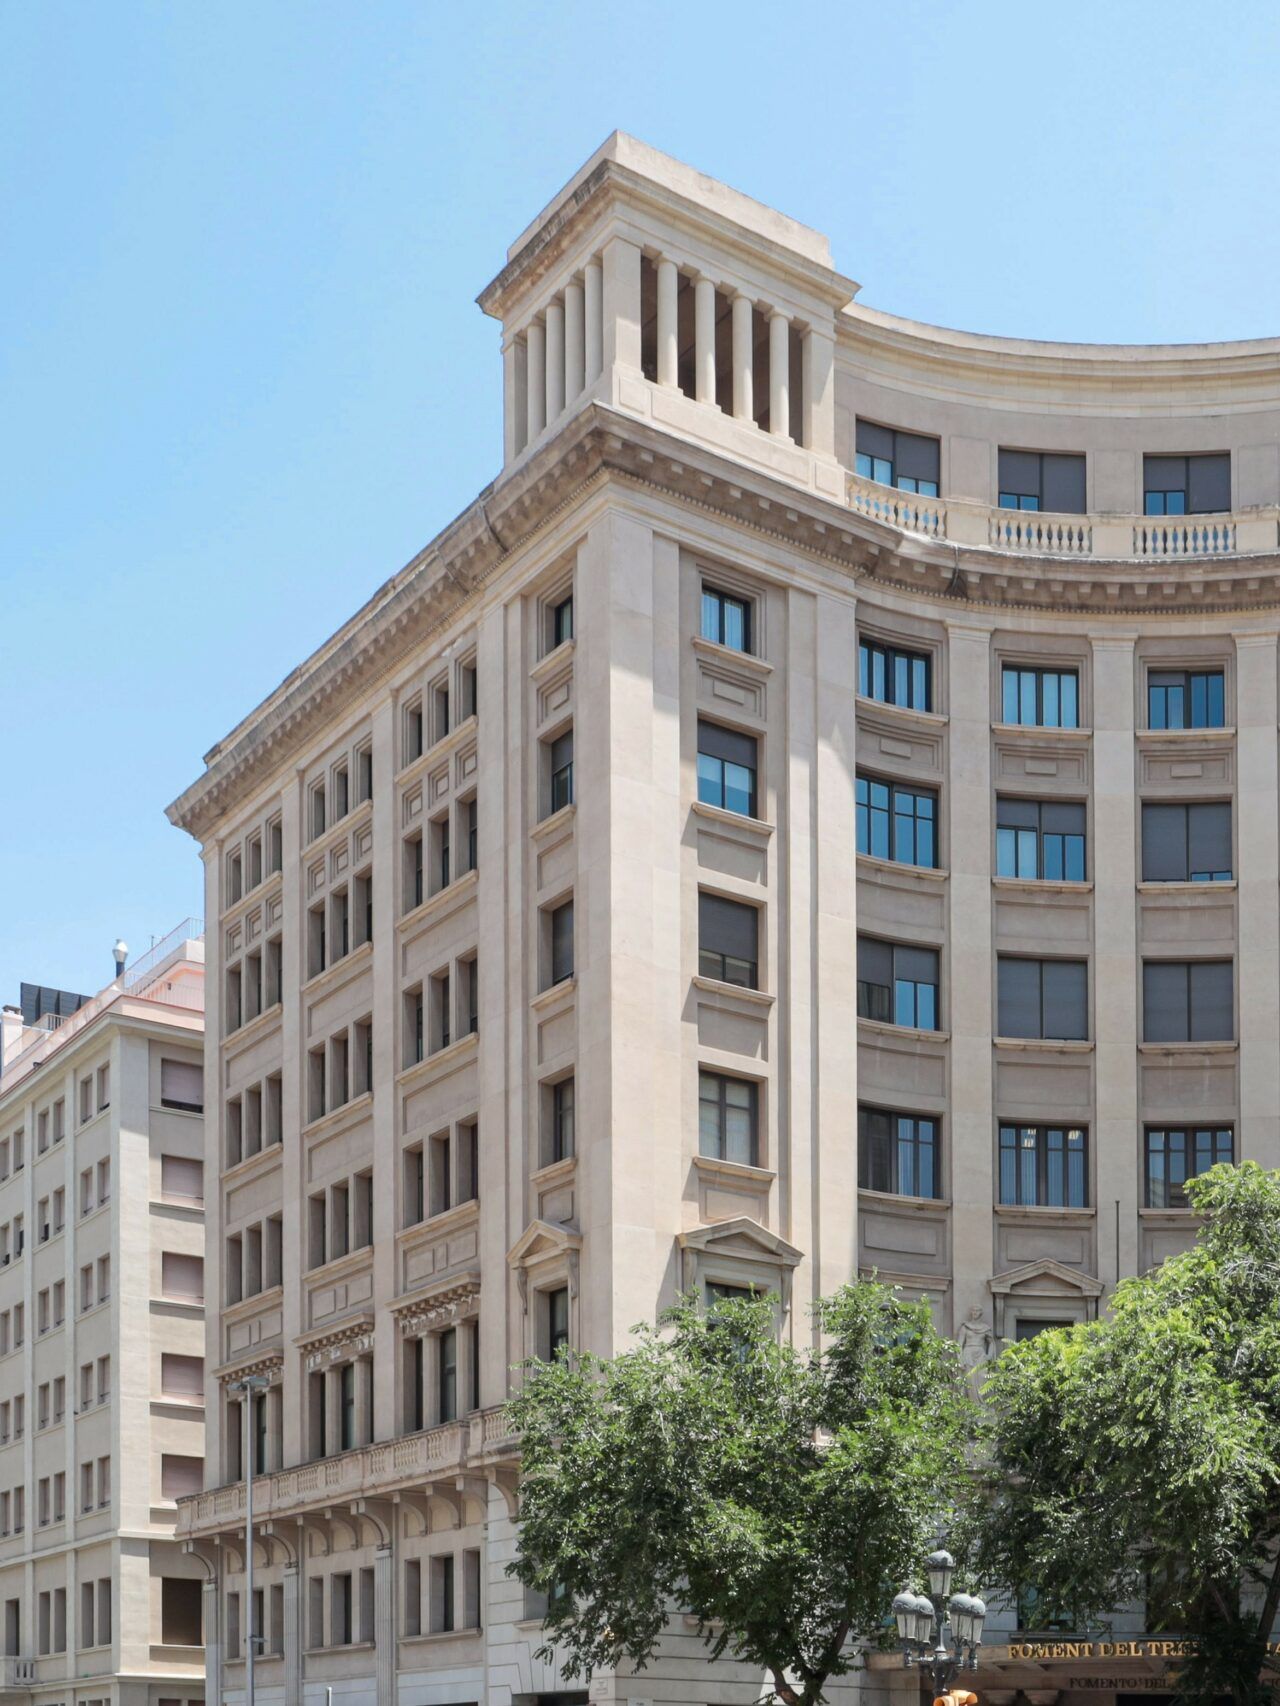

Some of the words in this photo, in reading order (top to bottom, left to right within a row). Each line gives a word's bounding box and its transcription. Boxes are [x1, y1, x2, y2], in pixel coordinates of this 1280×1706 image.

[1007, 1642, 1093, 1659] FOMENT
[1099, 1641, 1143, 1657] DEL
[1069, 1678, 1137, 1689] FOMENTO
[1144, 1678, 1169, 1689] DEL
